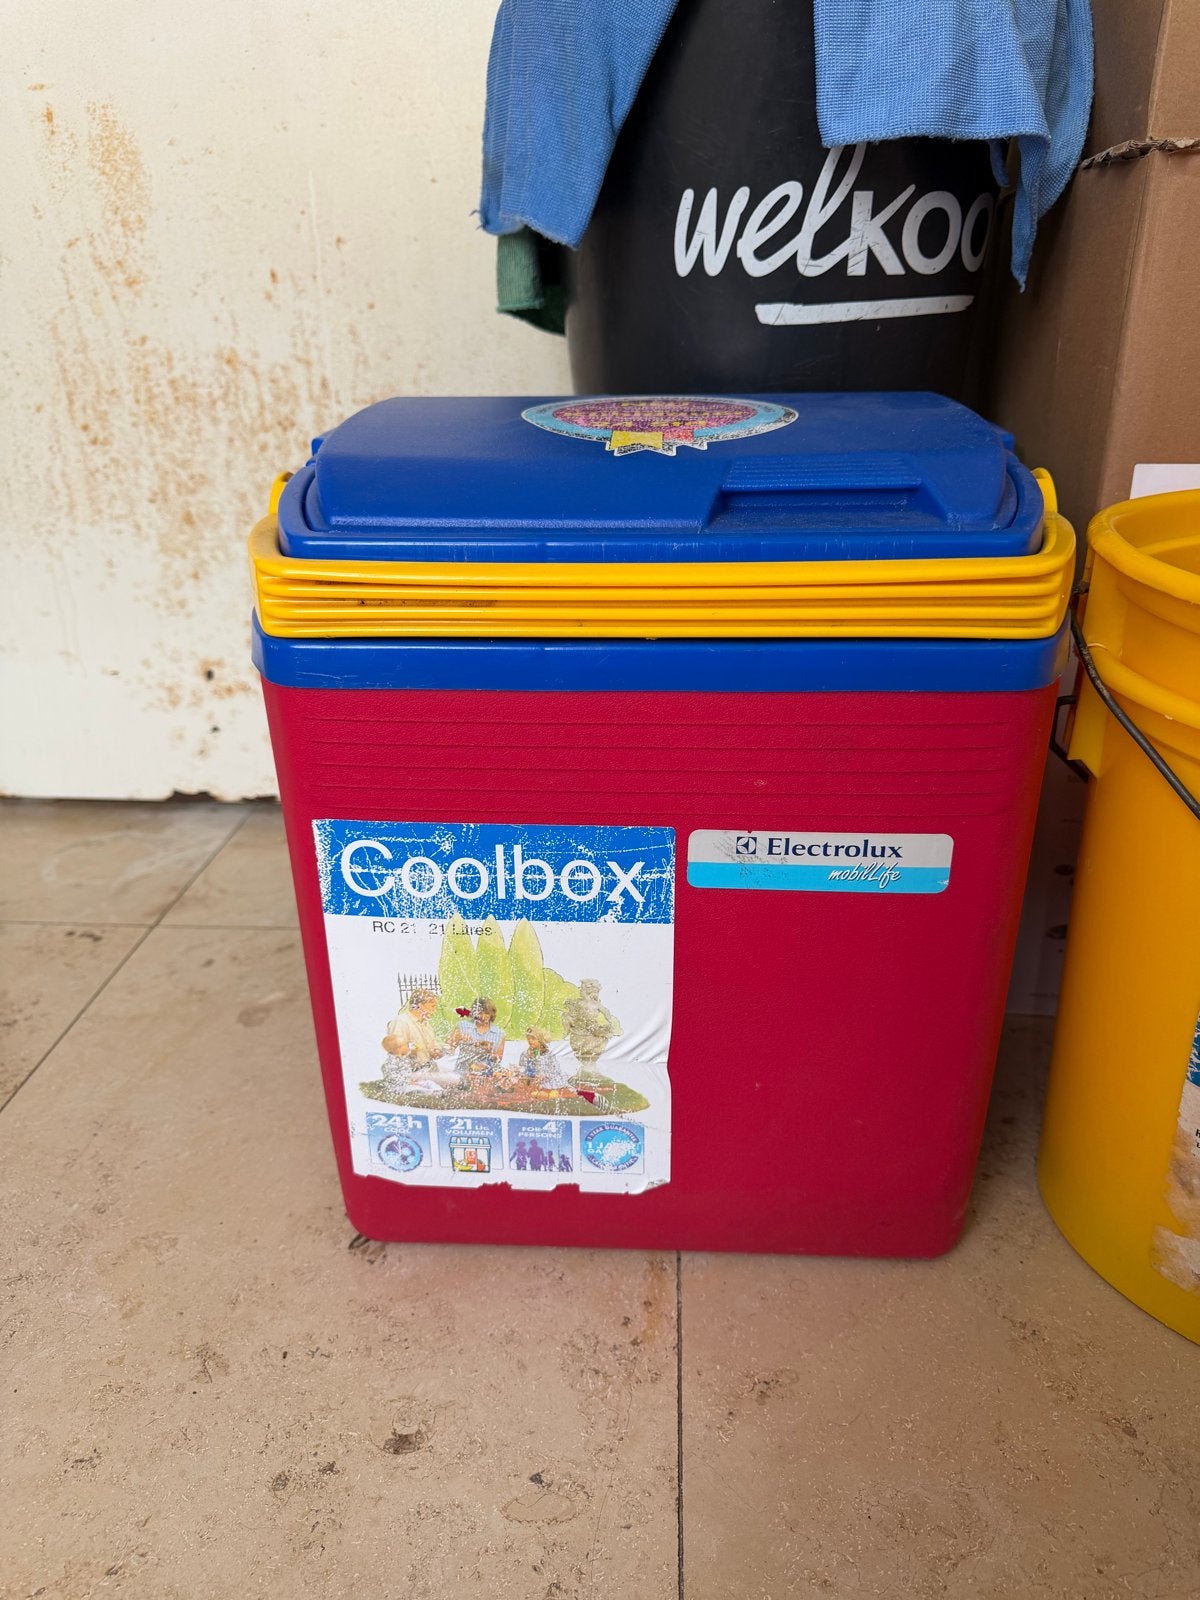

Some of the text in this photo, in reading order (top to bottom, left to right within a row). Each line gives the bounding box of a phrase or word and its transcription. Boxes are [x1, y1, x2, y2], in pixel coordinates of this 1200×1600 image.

[767, 837, 904, 859] Electrolux
[340, 839, 646, 903] Coolbox
[372, 920, 396, 934] RC
[428, 923, 445, 936] 21
[449, 1118, 472, 1130] 21
